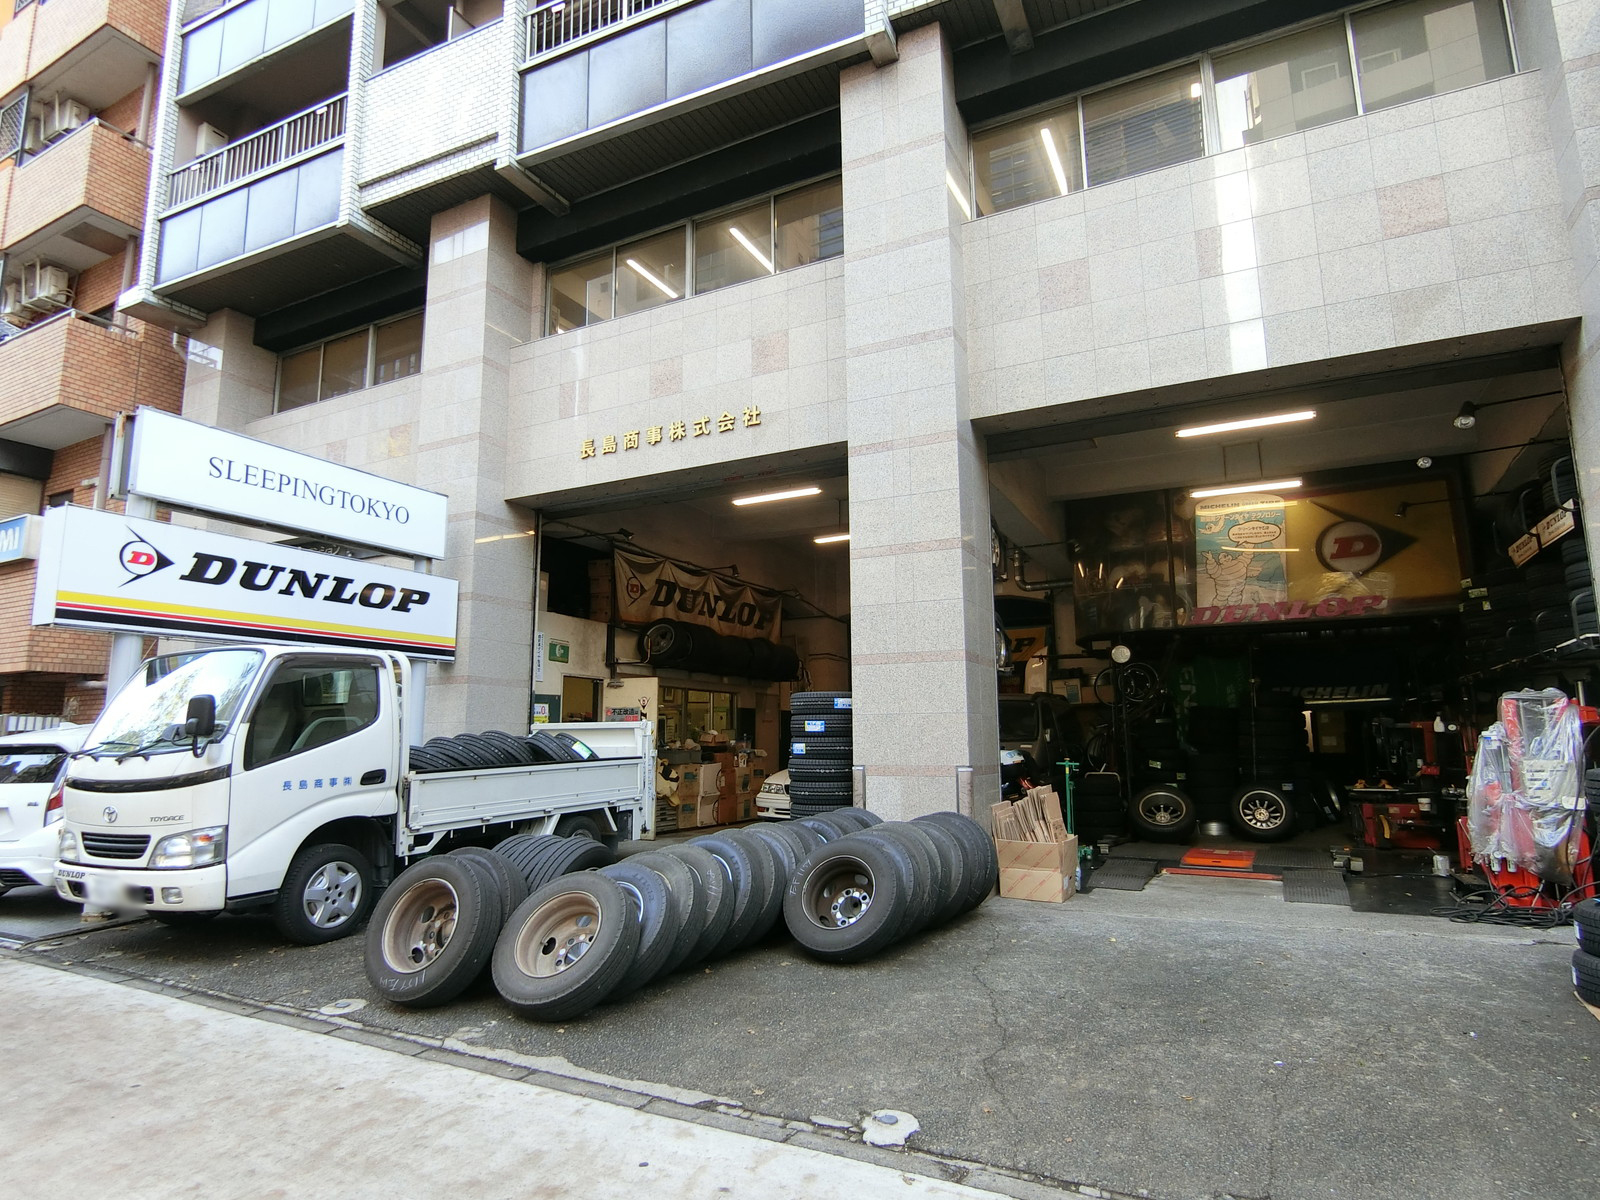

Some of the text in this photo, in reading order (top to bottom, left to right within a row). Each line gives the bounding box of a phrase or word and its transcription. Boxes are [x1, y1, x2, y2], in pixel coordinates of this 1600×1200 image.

[580, 405, 761, 460] 長島商事株式会社
[208, 456, 410, 525] SLEEPINGTOKYO
[1200, 502, 1240, 510] MICHELIN
[1329, 534, 1381, 560] D
[179, 551, 430, 613] DUNLOP
[650, 578, 773, 630] DUNLOP
[1190, 595, 1386, 625] DUNLOP
[1271, 683, 1390, 698] ICHELIN
[150, 814, 185, 822] TOYOACE
[57, 869, 86, 879] DUNLOP
